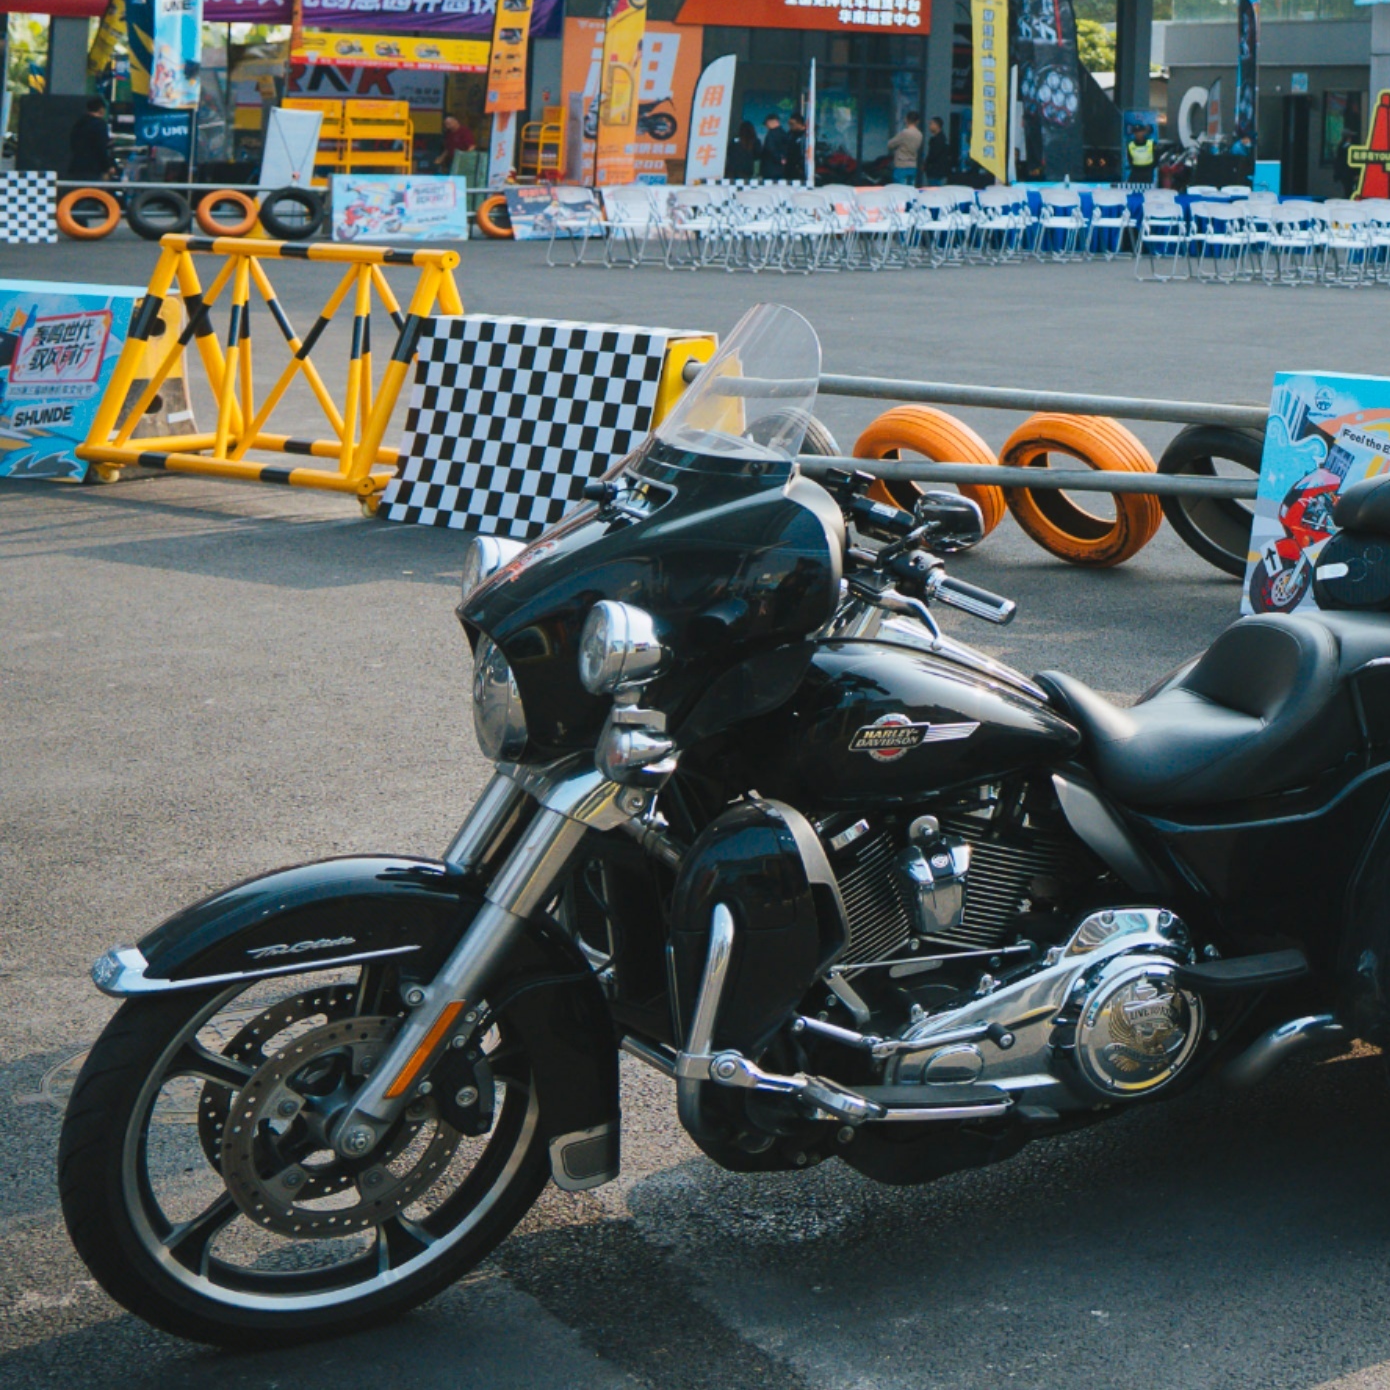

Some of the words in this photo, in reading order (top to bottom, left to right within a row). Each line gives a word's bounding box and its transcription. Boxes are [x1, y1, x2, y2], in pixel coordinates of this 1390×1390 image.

[33, 318, 96, 352] 轰鸣世代
[28, 343, 93, 374] 驭风前行
[14, 406, 73, 429] SHUNDE
[1342, 428, 1367, 446] Feel
[1366, 436, 1382, 452] the
[855, 736, 920, 748] DAVIDSON
